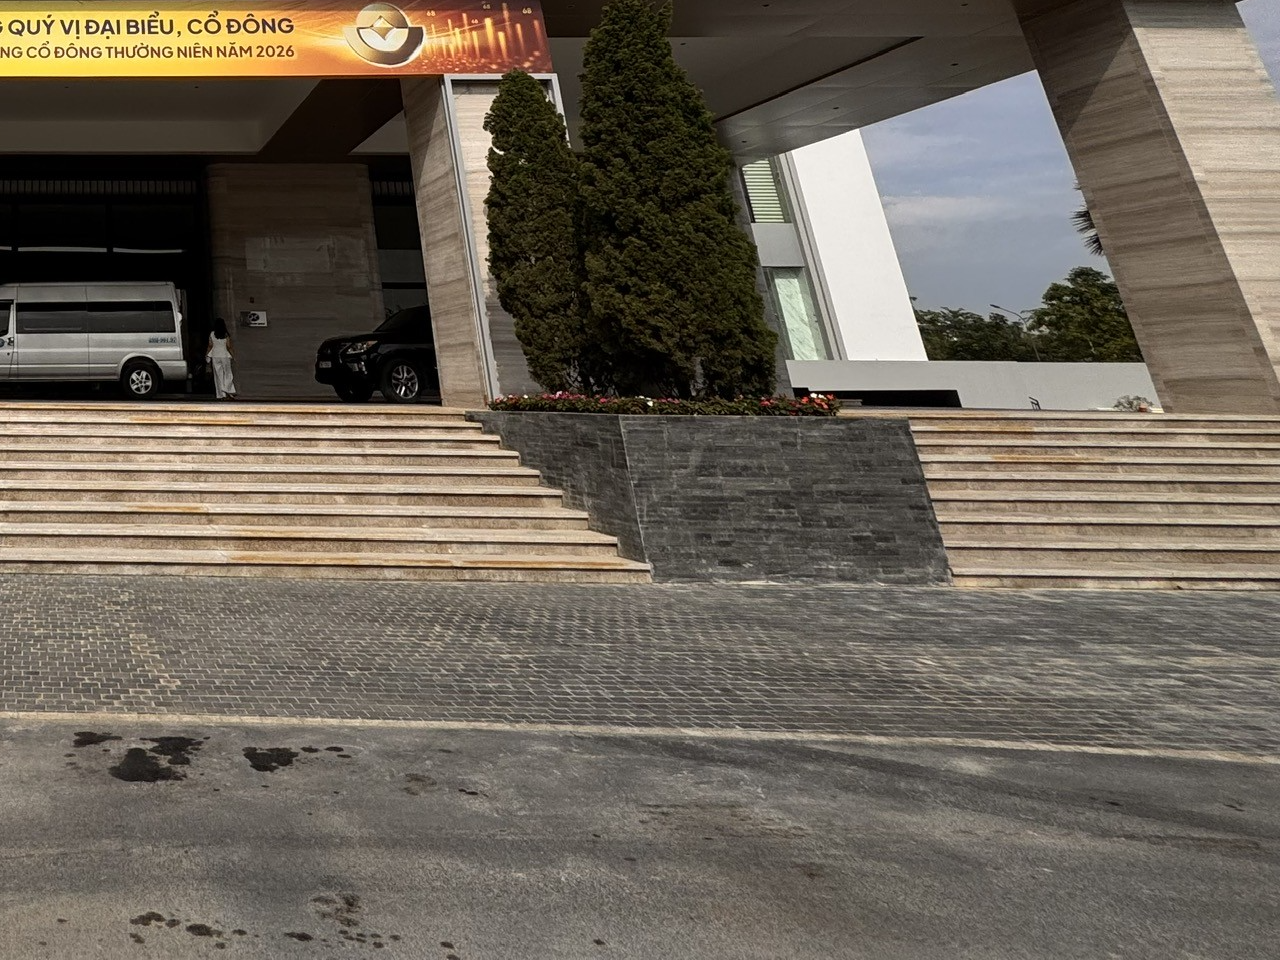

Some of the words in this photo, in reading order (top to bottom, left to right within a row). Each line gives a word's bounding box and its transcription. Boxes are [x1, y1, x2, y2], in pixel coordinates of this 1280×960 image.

[522, 7, 532, 15] 68
[8, 14, 56, 37] QUÝ
[60, 19, 81, 40] VỊ
[85, 19, 121, 40] ĐẠI
[187, 10, 220, 35] CỔ
[226, 13, 295, 35] ĐÔNG
[26, 41, 51, 58] CỔ
[54, 42, 102, 58] ĐÔNG
[105, 42, 174, 58] THƯỜNG
[177, 42, 213, 58] NIÊN
[217, 42, 252, 58] NĂM
[256, 45, 295, 58] 2026
